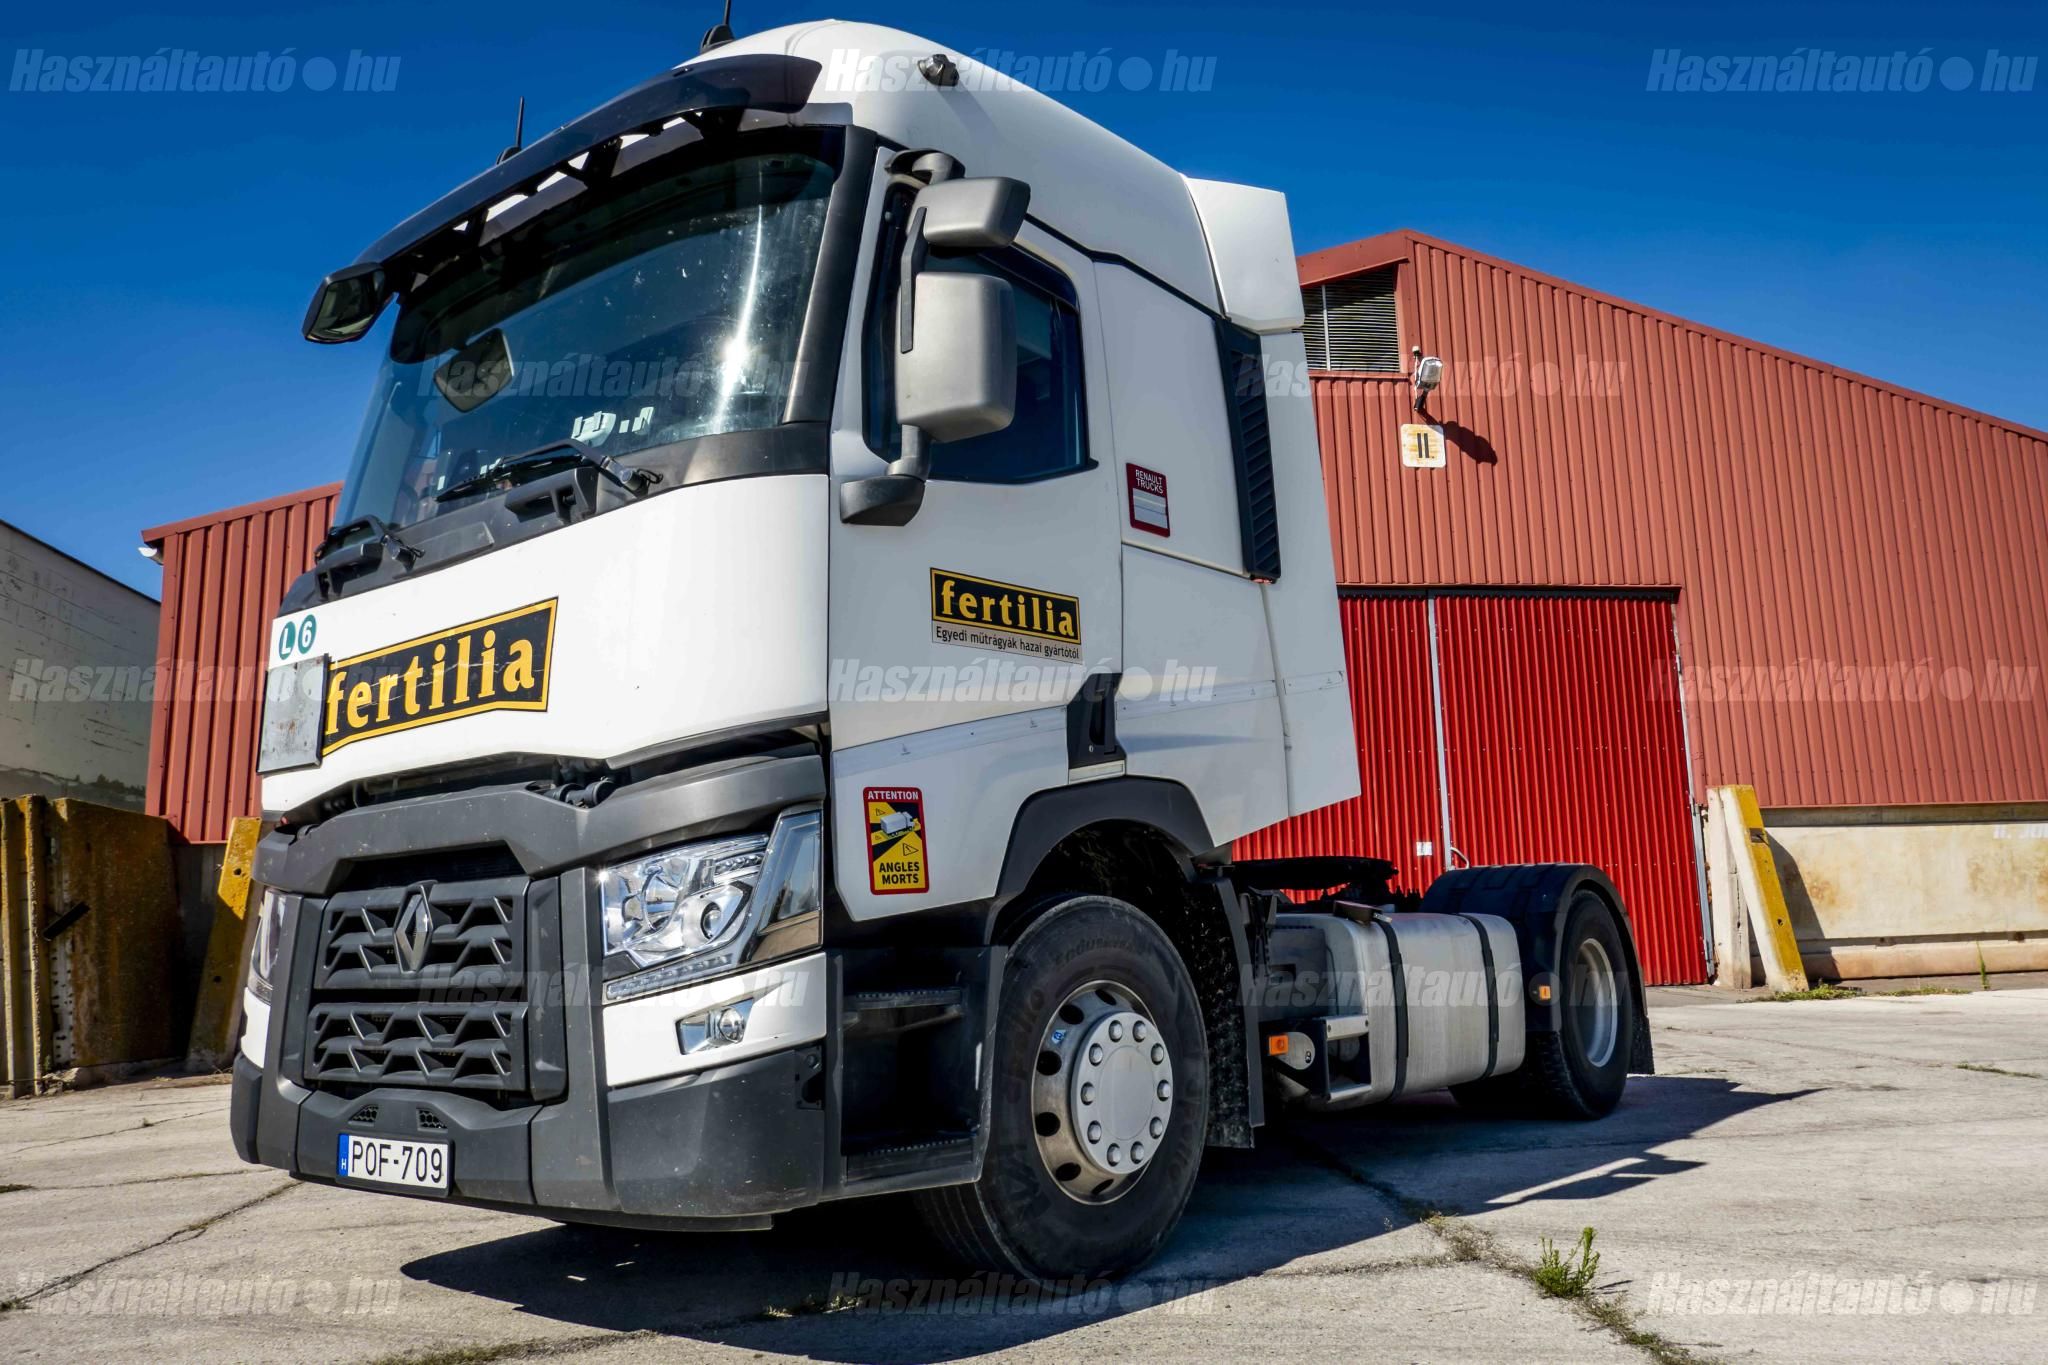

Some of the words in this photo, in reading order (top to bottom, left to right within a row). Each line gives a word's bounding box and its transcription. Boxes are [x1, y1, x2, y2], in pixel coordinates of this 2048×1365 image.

[1135, 469, 1162, 485] RENAULT
[1136, 477, 1163, 494] TRUCKS
[941, 579, 1075, 637] fertilia
[300, 617, 314, 650] 6
[936, 625, 967, 642] Egyedi
[970, 631, 1017, 650] műtrágyák
[1019, 637, 1042, 653] hazai
[1044, 644, 1080, 660] gyártótól
[325, 629, 536, 736] fertilia
[867, 790, 919, 800] ATTENTION
[879, 861, 920, 873] ANGLES
[882, 873, 919, 885] MORTS
[341, 1158, 347, 1170] H
[351, 1140, 443, 1183] POF-709
